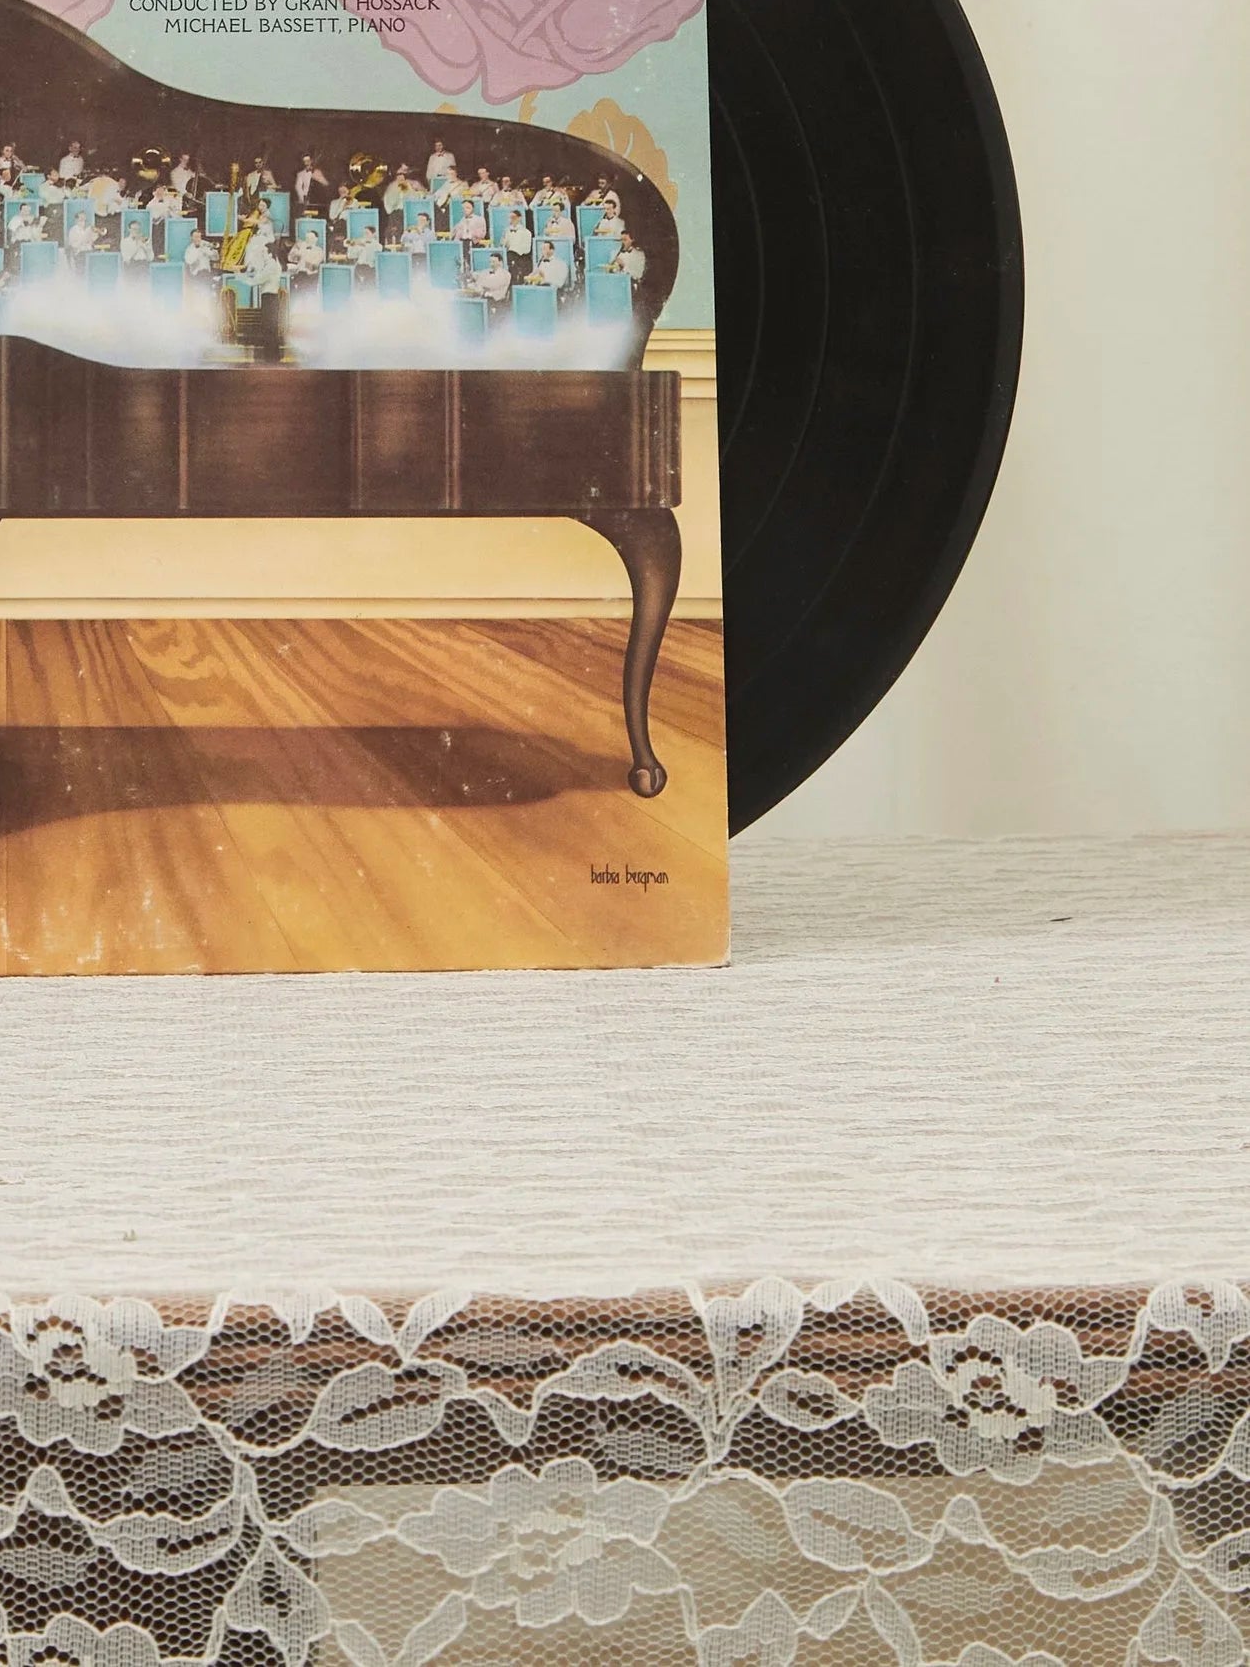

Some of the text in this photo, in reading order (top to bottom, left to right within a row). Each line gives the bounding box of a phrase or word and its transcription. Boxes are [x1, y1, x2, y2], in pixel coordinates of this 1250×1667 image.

[164, 17, 406, 35] MICHAEL BASSETT, PIANO
[625, 863, 669, 893] bergman
